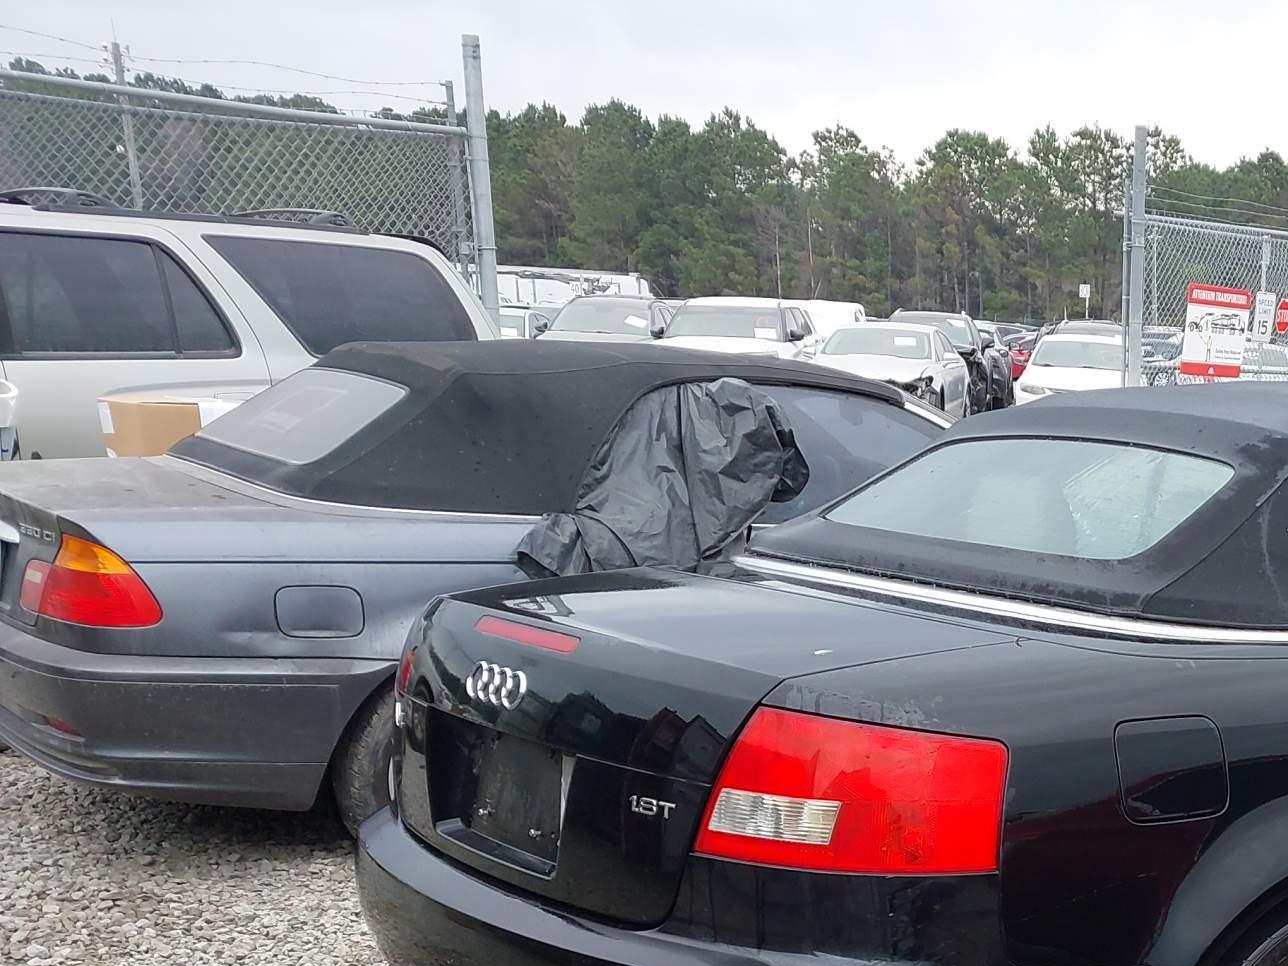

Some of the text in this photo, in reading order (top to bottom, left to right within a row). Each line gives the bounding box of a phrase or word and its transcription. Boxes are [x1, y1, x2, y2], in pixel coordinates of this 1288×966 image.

[1258, 298, 1274, 307] SPEED
[1258, 307, 1272, 315] LIMIT
[1257, 320, 1268, 335] 15
